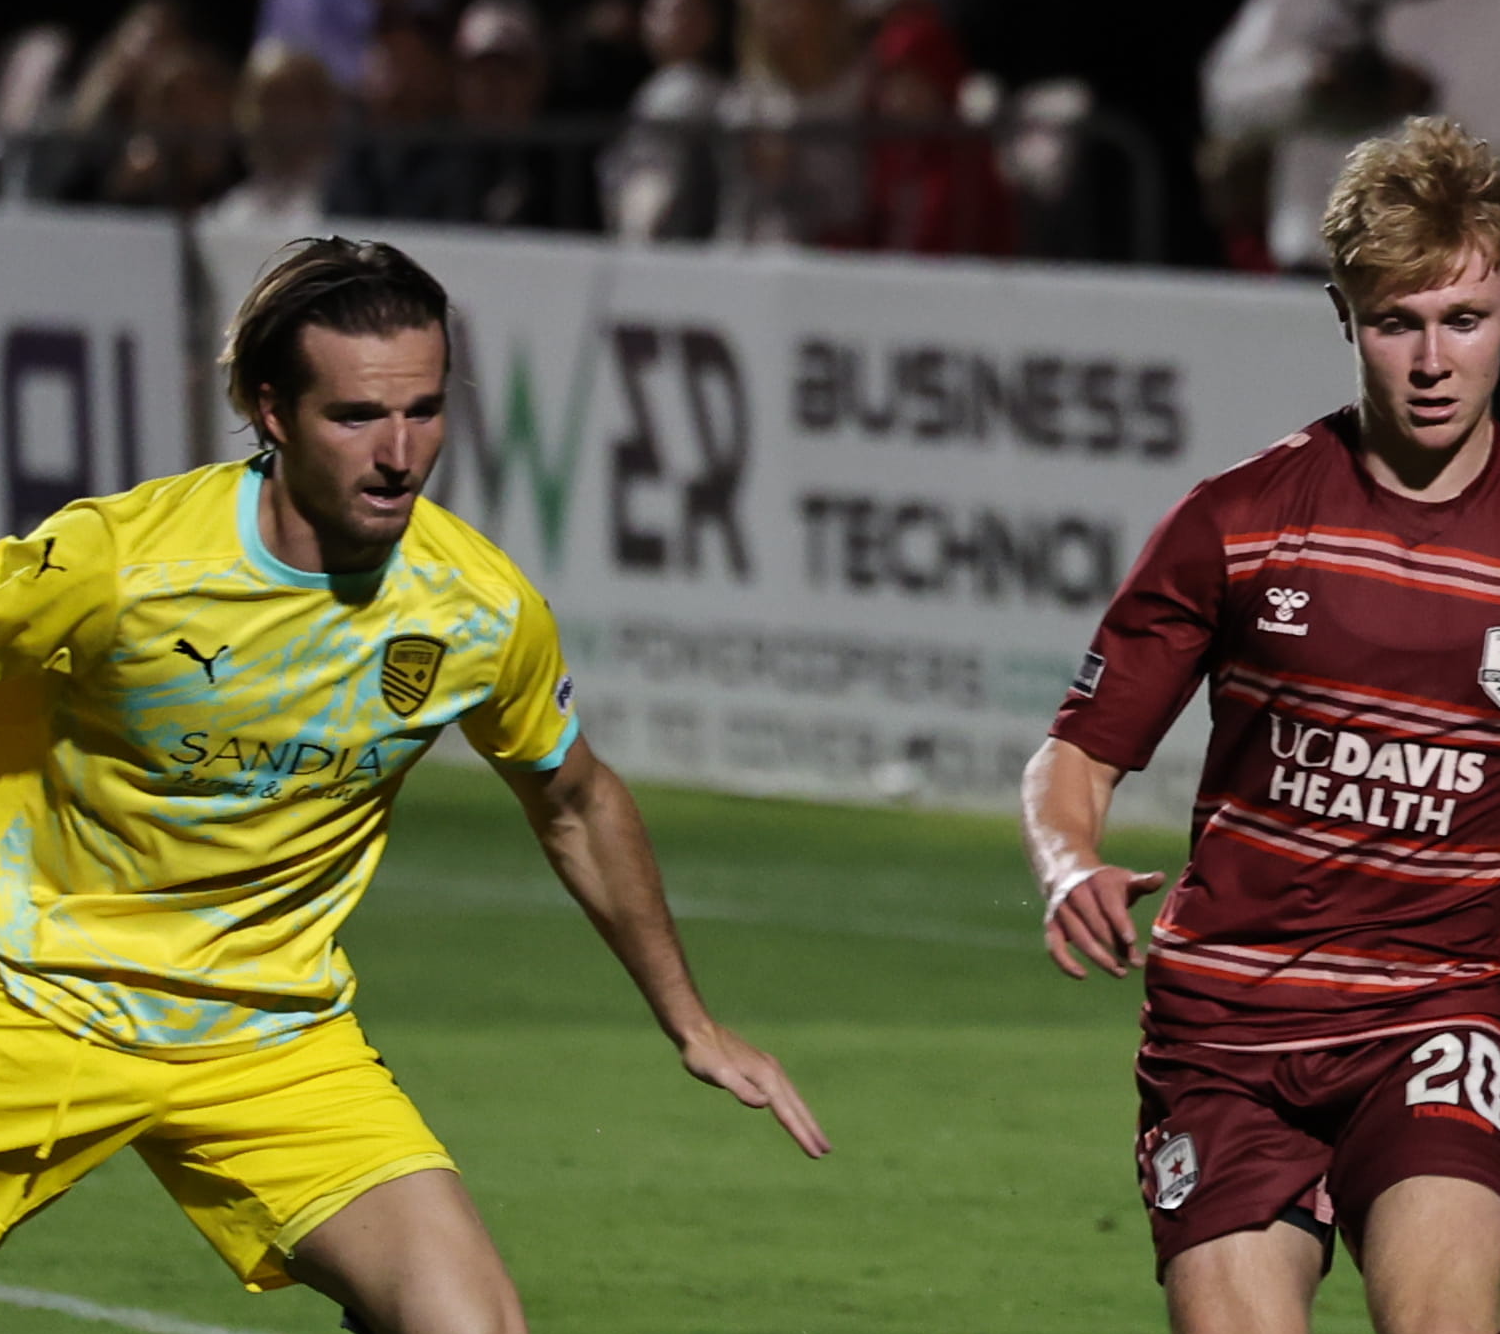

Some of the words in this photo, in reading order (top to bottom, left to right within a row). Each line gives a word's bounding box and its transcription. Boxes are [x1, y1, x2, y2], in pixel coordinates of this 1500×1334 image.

[794, 335, 1188, 459] BUSINESS
[168, 732, 383, 779] SANDIA
[1268, 765, 1456, 836] HEALTH
